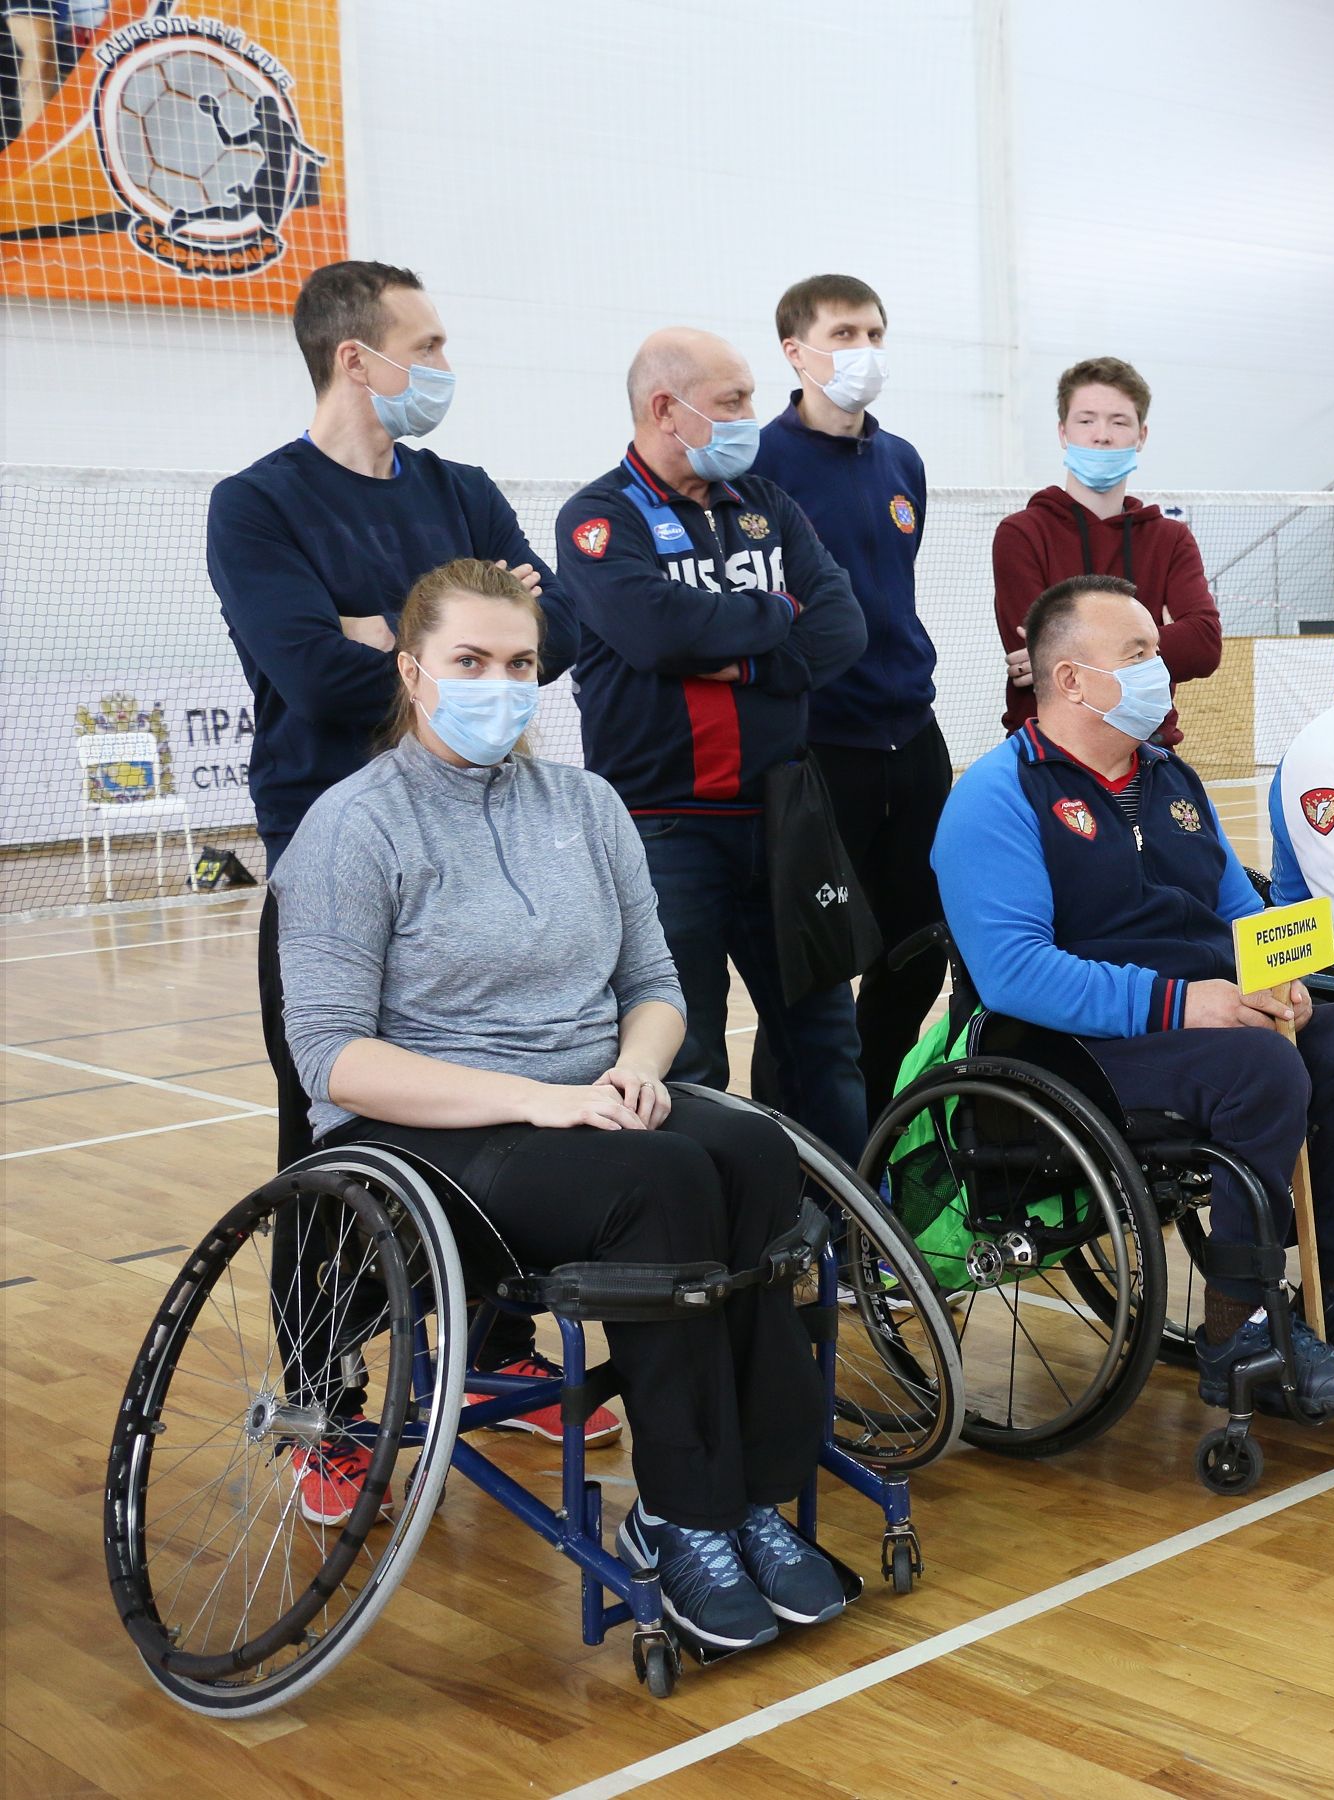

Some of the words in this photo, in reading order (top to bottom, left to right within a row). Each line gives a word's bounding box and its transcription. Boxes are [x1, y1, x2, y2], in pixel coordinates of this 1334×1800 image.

[96, 17, 244, 66] ГАНДБОЛЬНЫЙ
[248, 44, 293, 89] КЛУБ
[1256, 917, 1317, 946] РЕСПУБЛИКА
[1266, 943, 1312, 968] ЧУВАШИЯ
